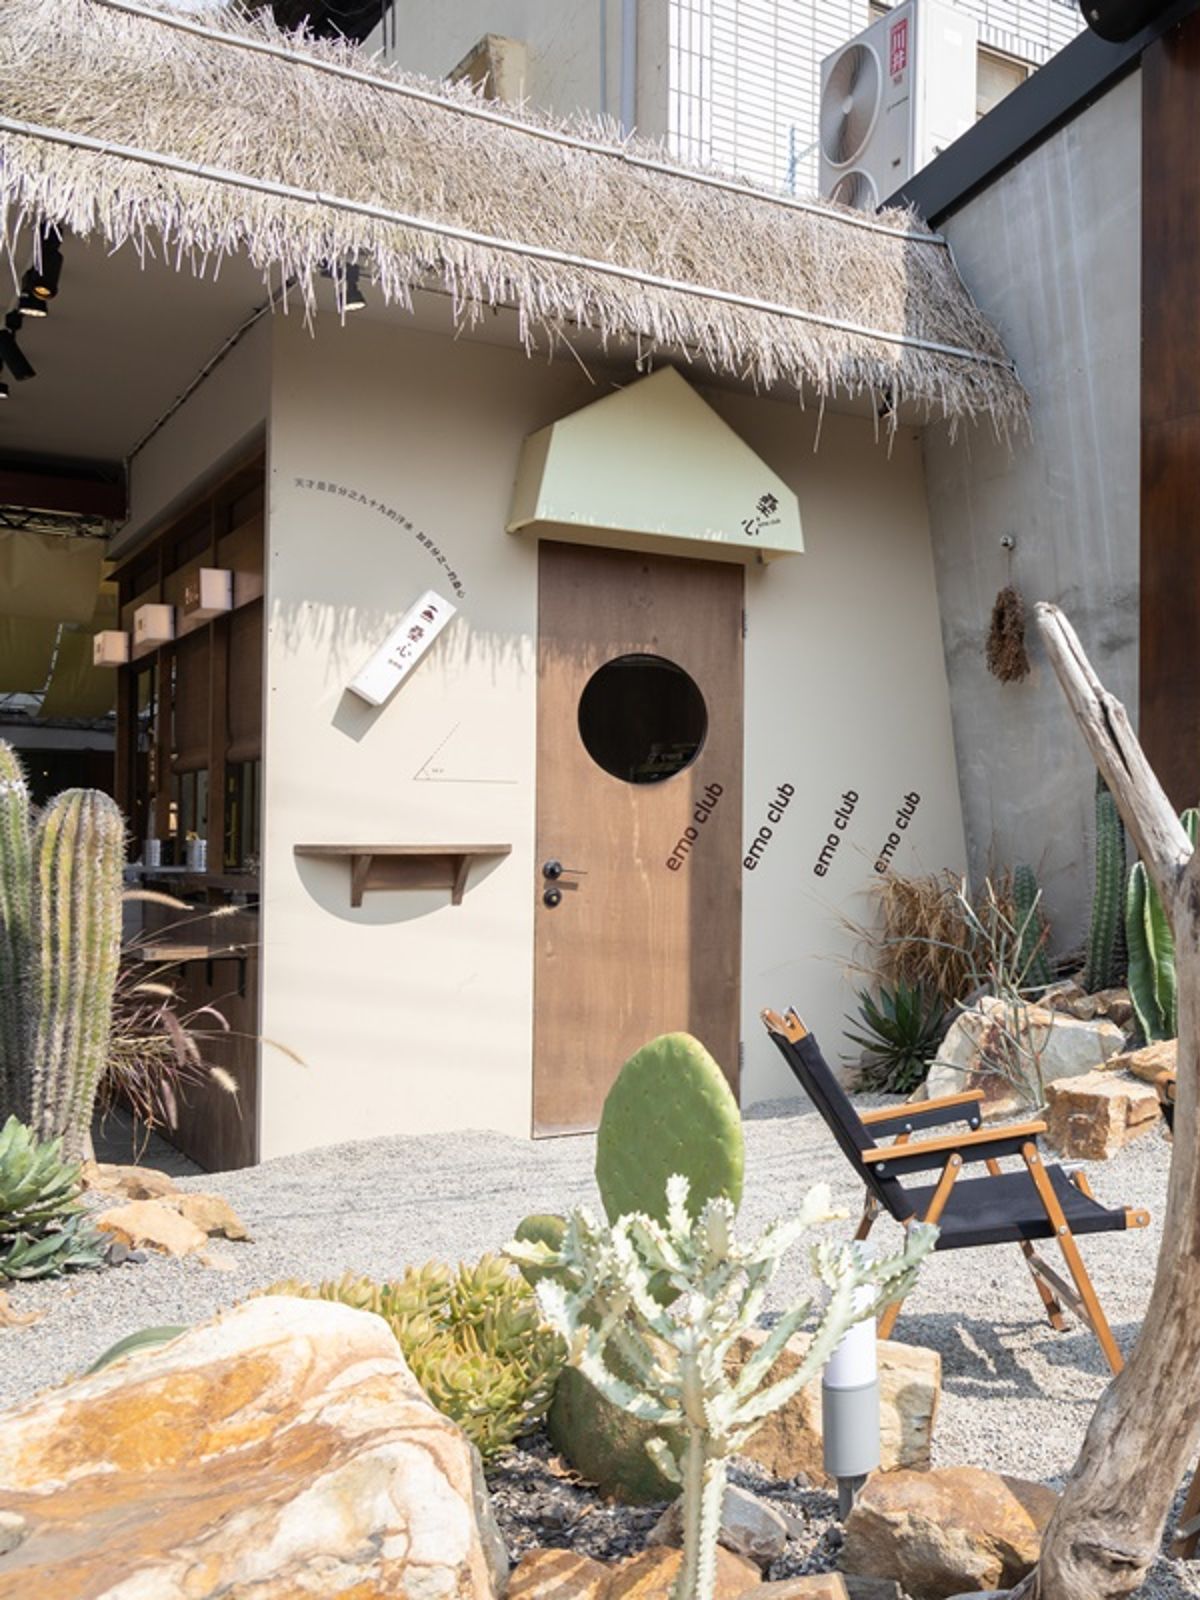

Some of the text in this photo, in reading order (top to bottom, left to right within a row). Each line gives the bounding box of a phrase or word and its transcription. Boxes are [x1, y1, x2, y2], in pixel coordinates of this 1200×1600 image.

[665, 782, 724, 872] emo club
[743, 782, 796, 872] emo club
[813, 789, 860, 878] emo club
[873, 790, 921, 875] emo club
